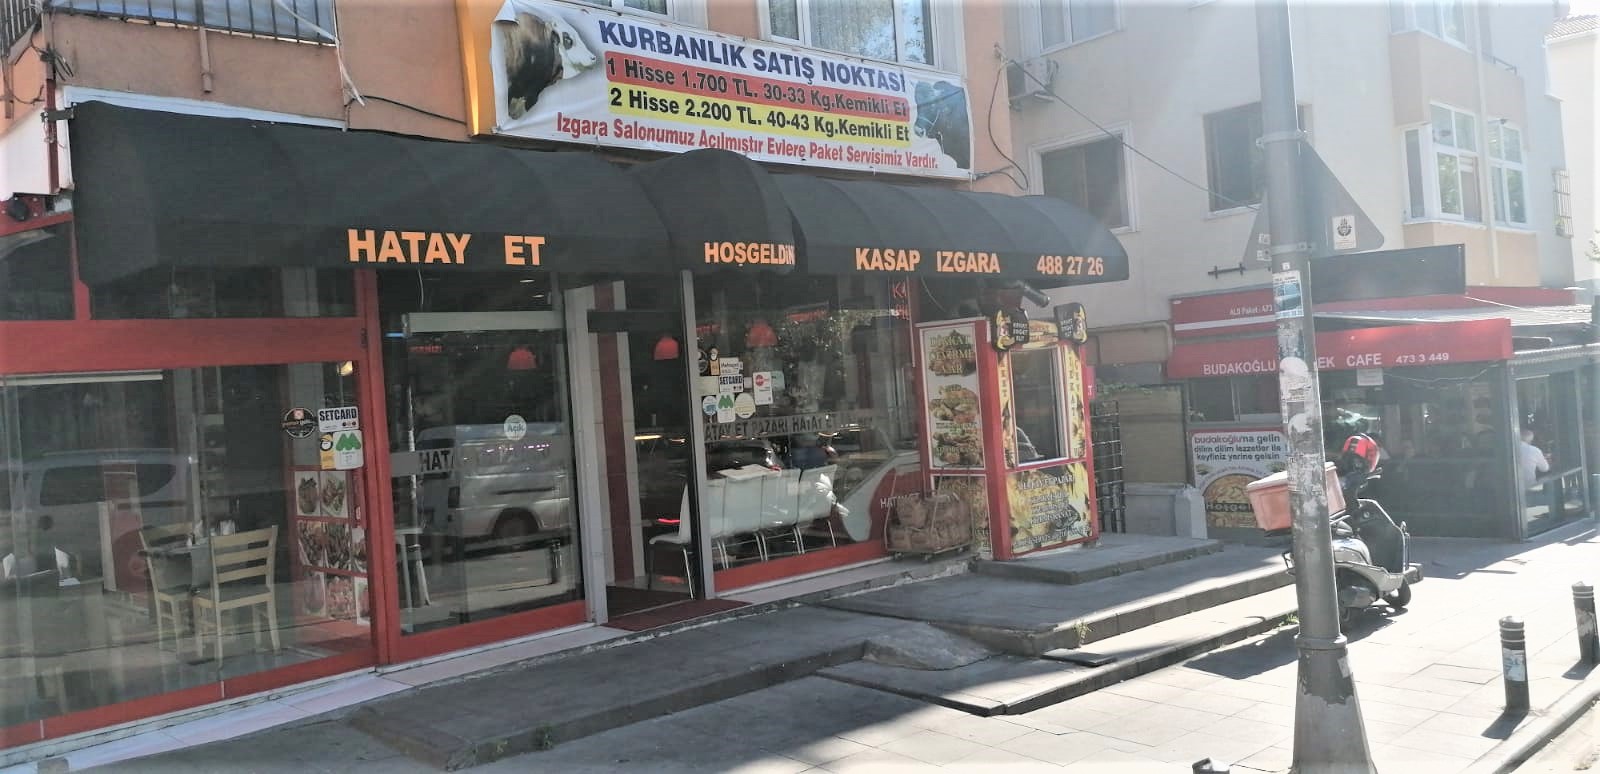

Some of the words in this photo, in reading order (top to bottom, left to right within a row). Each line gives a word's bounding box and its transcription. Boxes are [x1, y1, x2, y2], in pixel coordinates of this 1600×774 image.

[599, 20, 746, 68] KURBANLIK
[753, 48, 814, 84] SATIŞ
[821, 61, 905, 92] NOKTASI
[607, 58, 616, 76] 1
[624, 59, 675, 85] Hisse
[682, 71, 727, 93] 1.700
[732, 78, 758, 97] TL.
[764, 83, 805, 104] 30-33
[894, 101, 907, 117] Et
[610, 88, 622, 106] 2
[629, 90, 680, 115] Hisse
[685, 99, 731, 122] 2.200
[736, 106, 762, 125] TL.
[766, 111, 809, 131] 40-43
[896, 126, 910, 141] Et
[557, 112, 608, 138] Izgara
[613, 118, 695, 146] Salonumuz
[767, 138, 805, 157] Evlere
[809, 142, 843, 161] Paket
[847, 145, 903, 165] Servisimiz
[905, 152, 938, 168] Vardır.
[348, 229, 472, 264] HATAY
[504, 235, 546, 266] ET
[855, 247, 920, 272] KASAP
[937, 251, 1000, 274] IZGARA
[1036, 255, 1063, 275] 488
[1067, 256, 1082, 275] 27
[1087, 256, 1104, 275] 26
[1203, 360, 1276, 375] BUDAKOĞLU
[1346, 353, 1382, 367] CAFE
[319, 408, 358, 422] SETCARD
[1214, 444, 1234, 453] dilim
[1256, 433, 1280, 444] gelin
